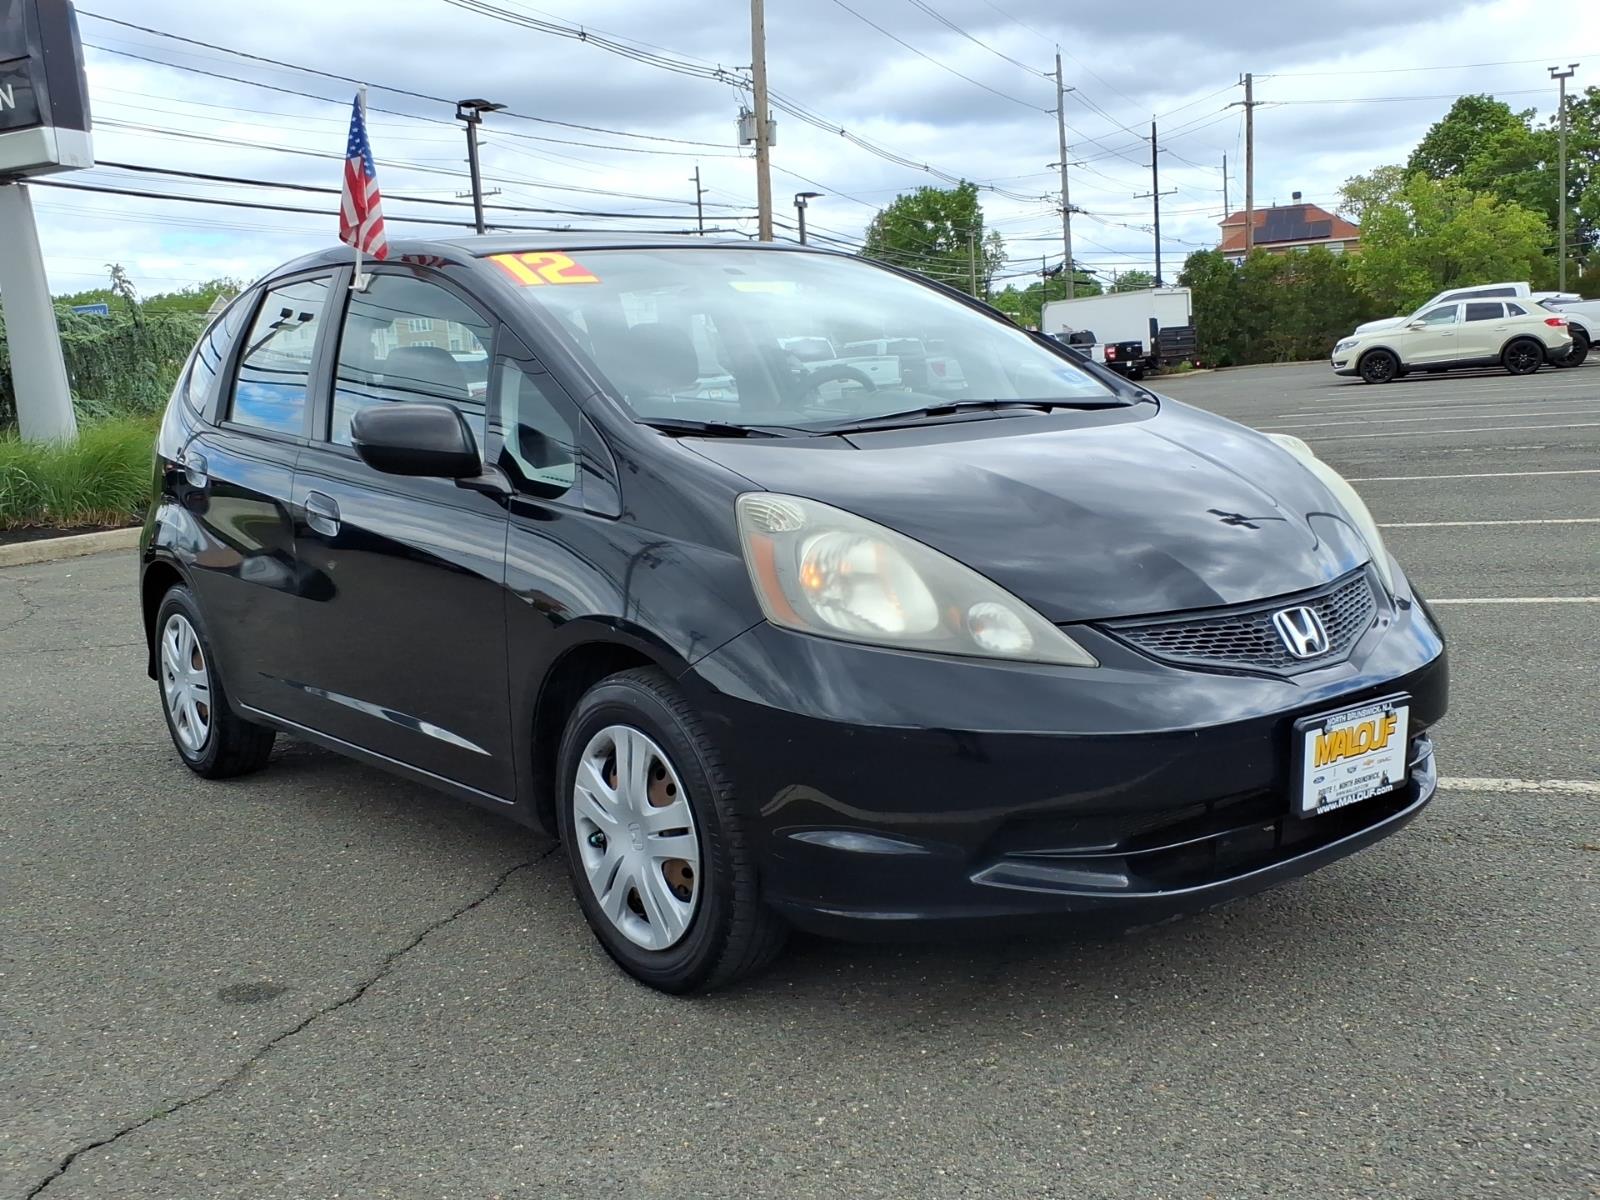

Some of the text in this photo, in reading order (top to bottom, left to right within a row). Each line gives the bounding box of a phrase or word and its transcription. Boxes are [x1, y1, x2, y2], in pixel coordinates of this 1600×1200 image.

[489, 251, 600, 285] 12
[1314, 715, 1397, 768] MALOUF
[1316, 784, 1393, 815] www.MALOUF.com
